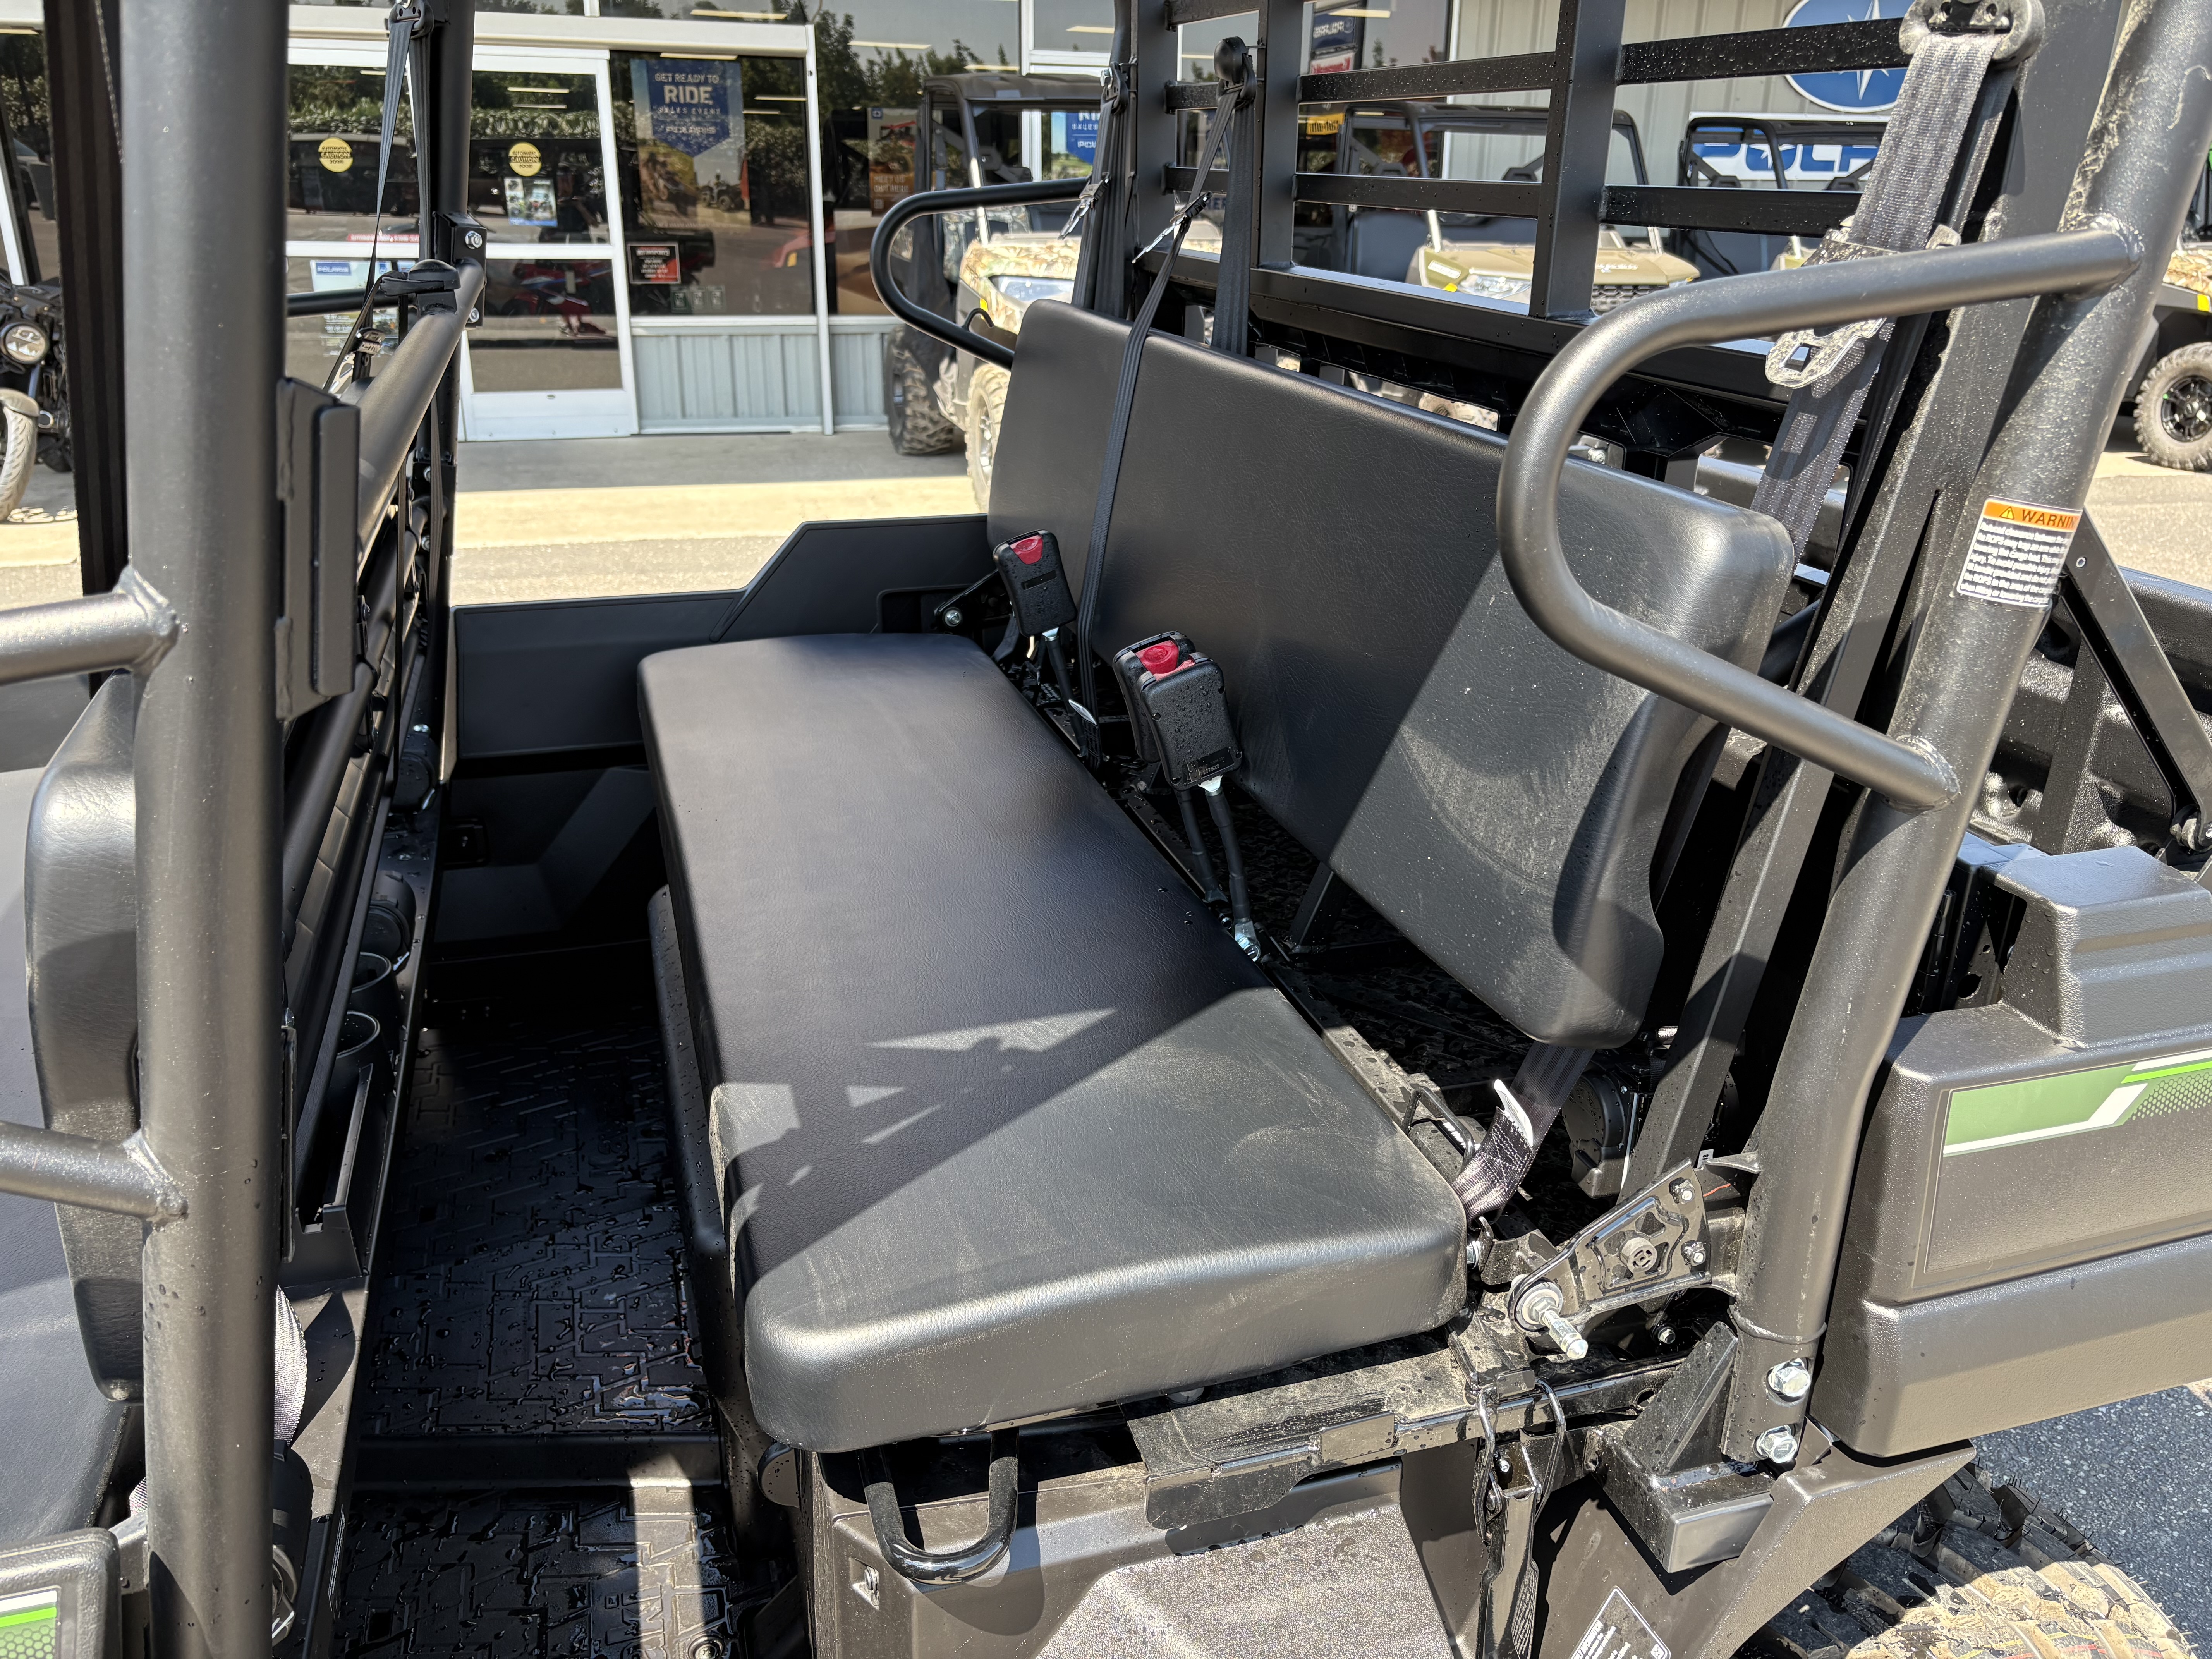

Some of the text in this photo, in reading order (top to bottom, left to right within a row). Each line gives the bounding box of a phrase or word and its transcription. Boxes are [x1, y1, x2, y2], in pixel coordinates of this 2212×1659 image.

[654, 72, 719, 84] GET READY TO
[663, 85, 714, 105] RIDE
